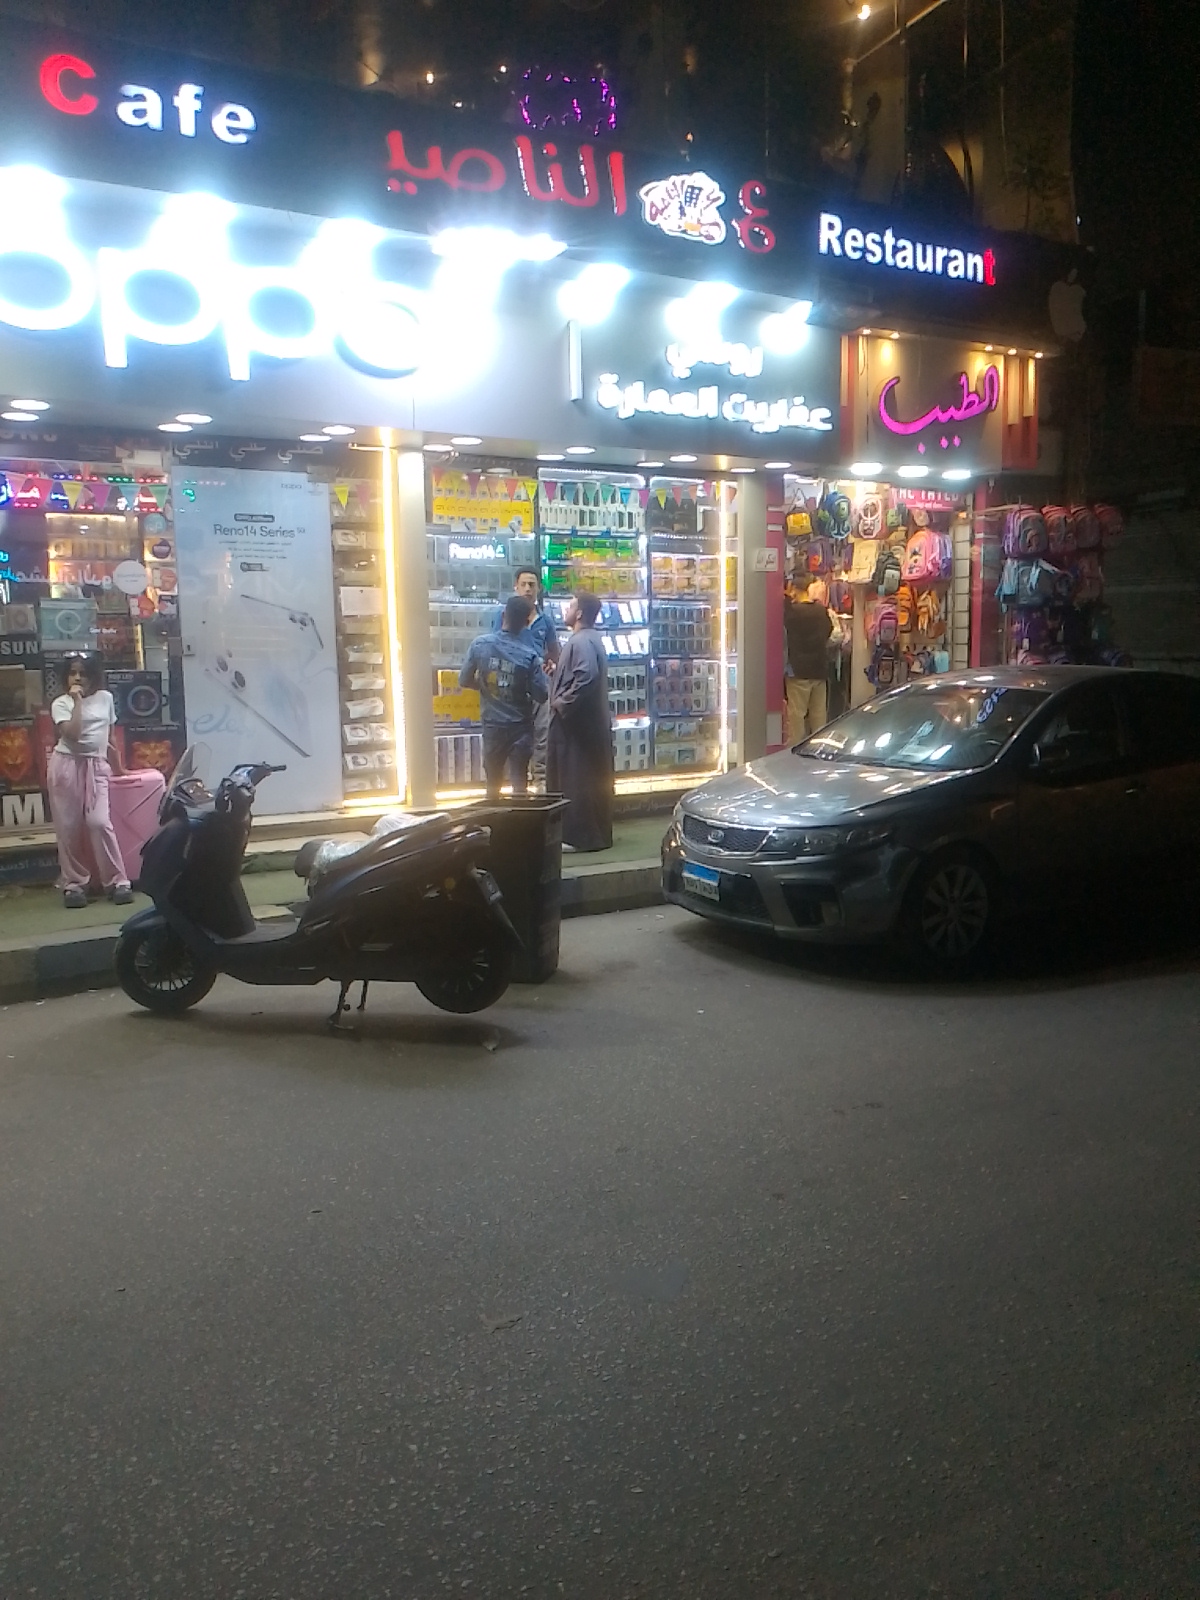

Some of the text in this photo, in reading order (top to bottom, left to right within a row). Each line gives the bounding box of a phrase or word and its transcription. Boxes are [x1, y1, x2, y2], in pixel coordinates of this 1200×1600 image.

[818, 211, 996, 286] Restaurant
[879, 365, 999, 455] الطيب
[213, 523, 257, 536] Reno14
[259, 525, 296, 539] Series
